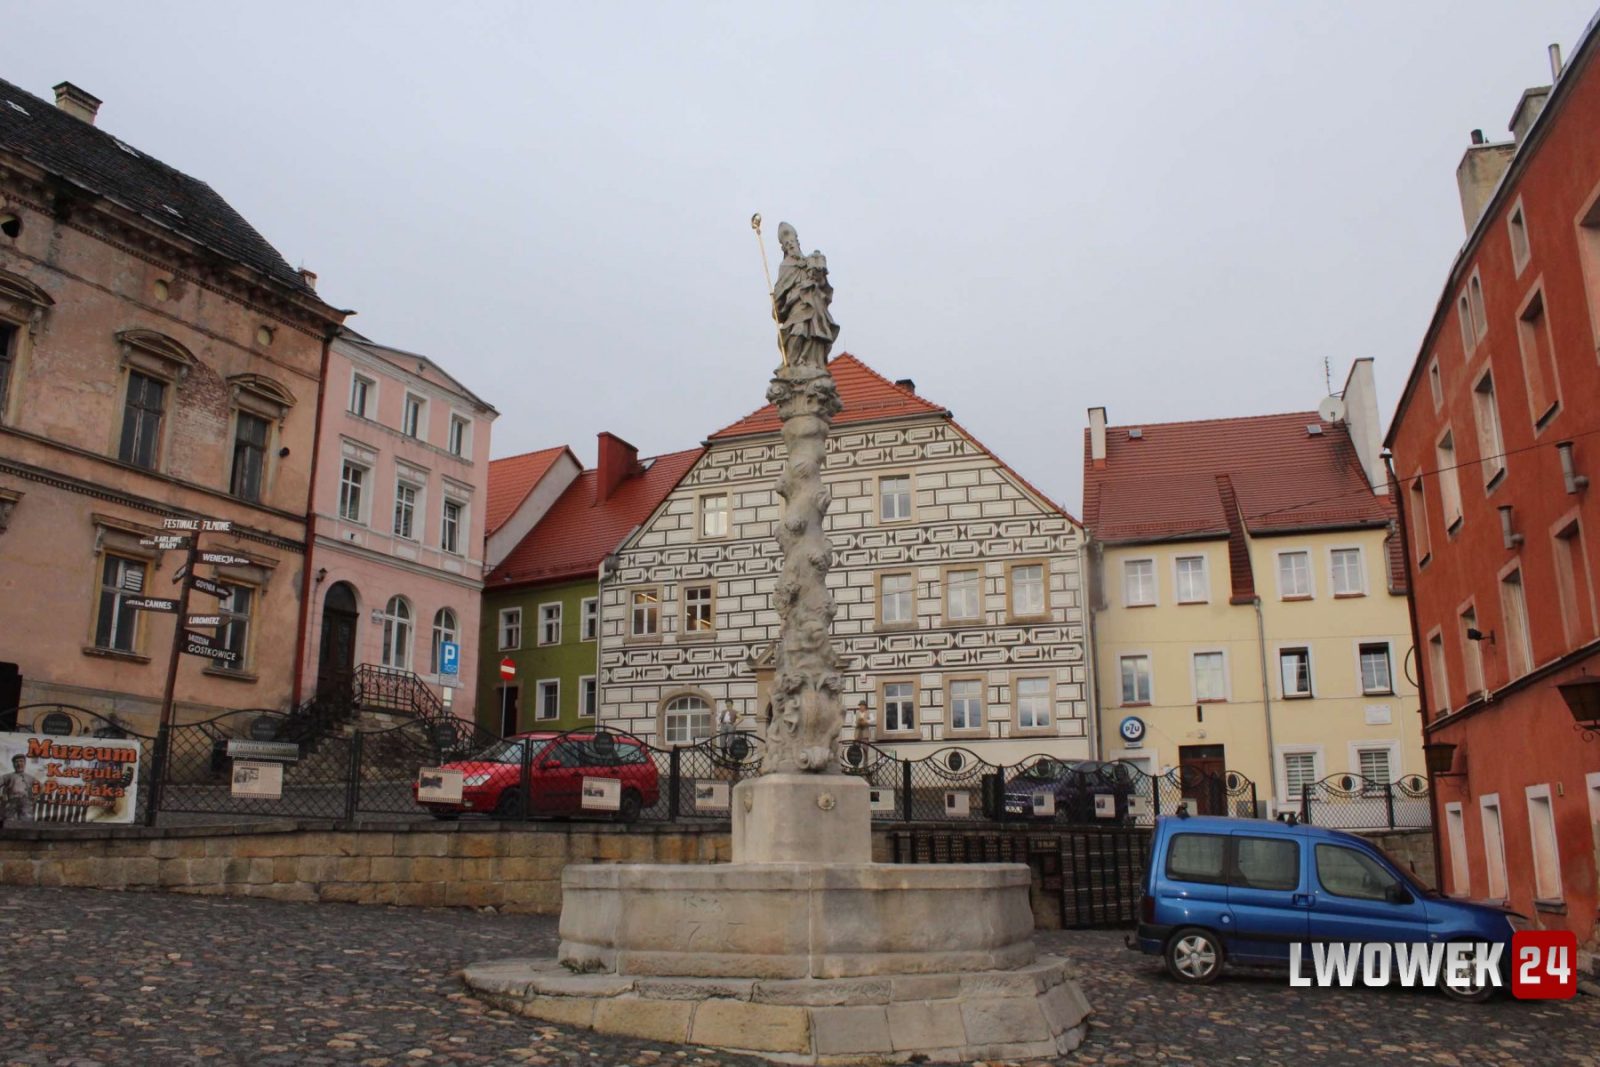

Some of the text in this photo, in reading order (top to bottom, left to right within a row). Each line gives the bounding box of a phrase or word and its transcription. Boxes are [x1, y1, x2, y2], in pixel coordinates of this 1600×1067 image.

[203, 553, 234, 564] WENECJA
[144, 599, 172, 610] CANNES
[188, 644, 236, 661] GOSTKOWICE
[444, 644, 456, 665] P
[1125, 723, 1140, 735] PZU
[27, 738, 137, 763] Muzeum
[46, 762, 122, 782] Kargula
[44, 780, 126, 798] Pawlaka
